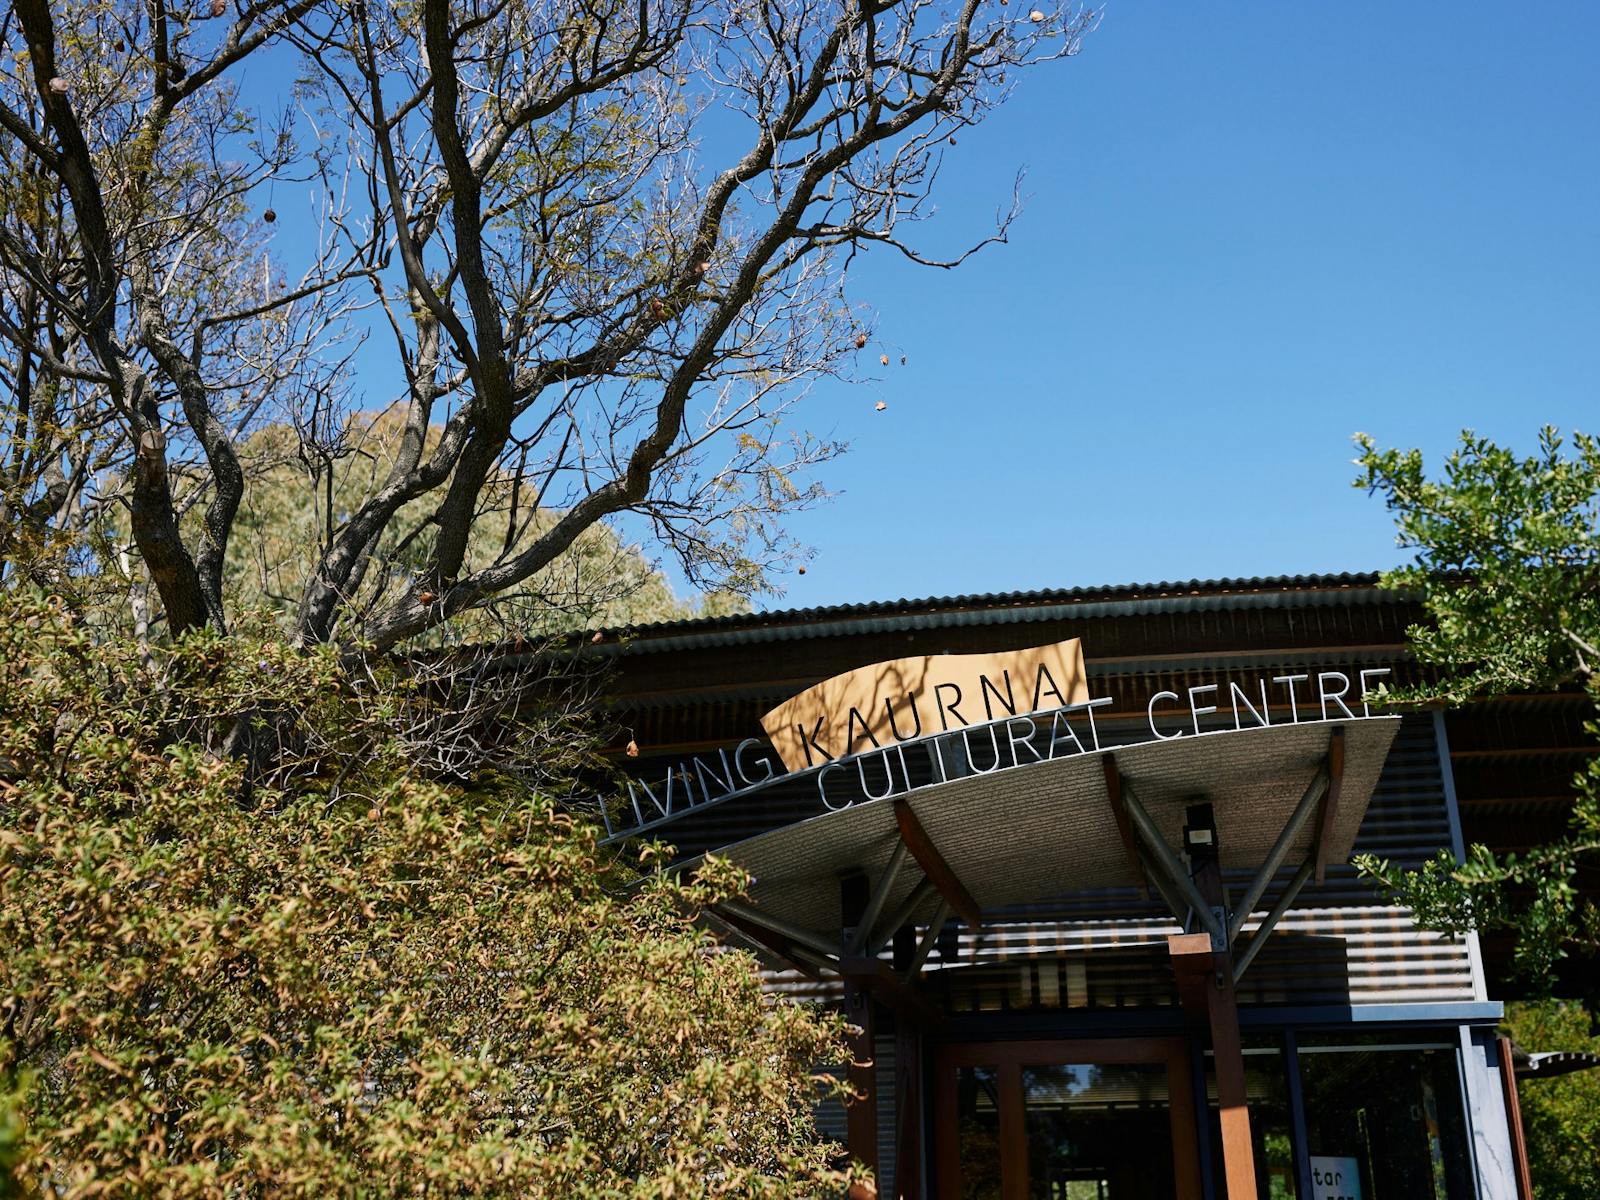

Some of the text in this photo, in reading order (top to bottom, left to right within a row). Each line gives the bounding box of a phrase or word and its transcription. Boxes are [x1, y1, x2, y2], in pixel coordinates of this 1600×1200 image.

[597, 662, 1066, 840] LIVING KAURNA
[817, 667, 1395, 811] CULTURAL CENTRE
[1312, 1167, 1342, 1187] tar
